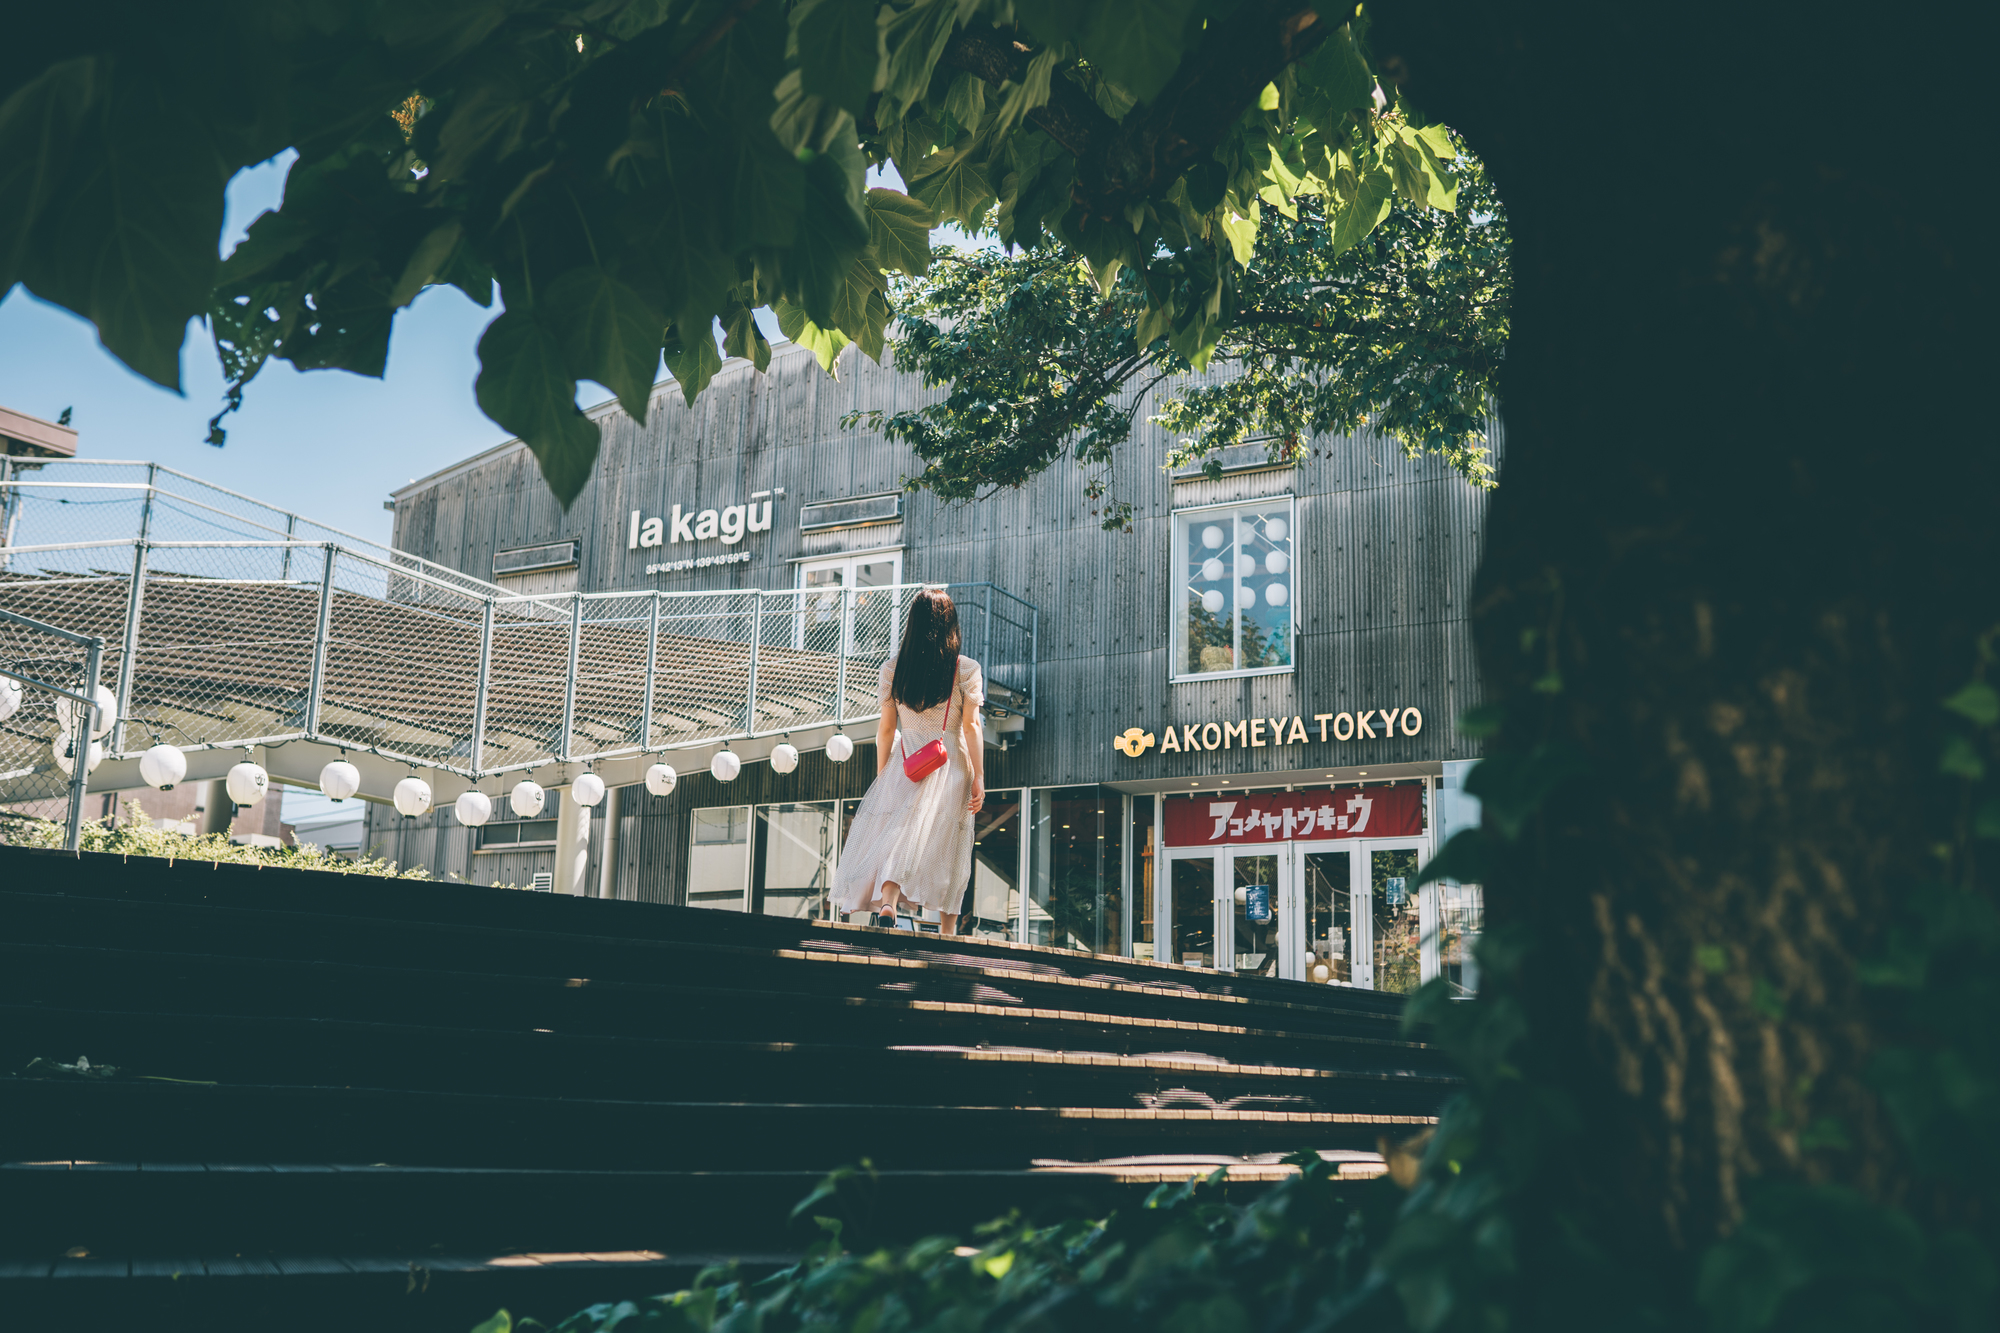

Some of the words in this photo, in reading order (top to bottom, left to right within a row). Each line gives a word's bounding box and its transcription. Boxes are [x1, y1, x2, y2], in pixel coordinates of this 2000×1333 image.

[629, 510, 663, 549] la
[670, 490, 772, 545] kagū
[1160, 715, 1309, 754] AKOMEYA
[1314, 707, 1423, 743] TOKYO
[1208, 793, 1374, 841] アコメヤトウキョウ
